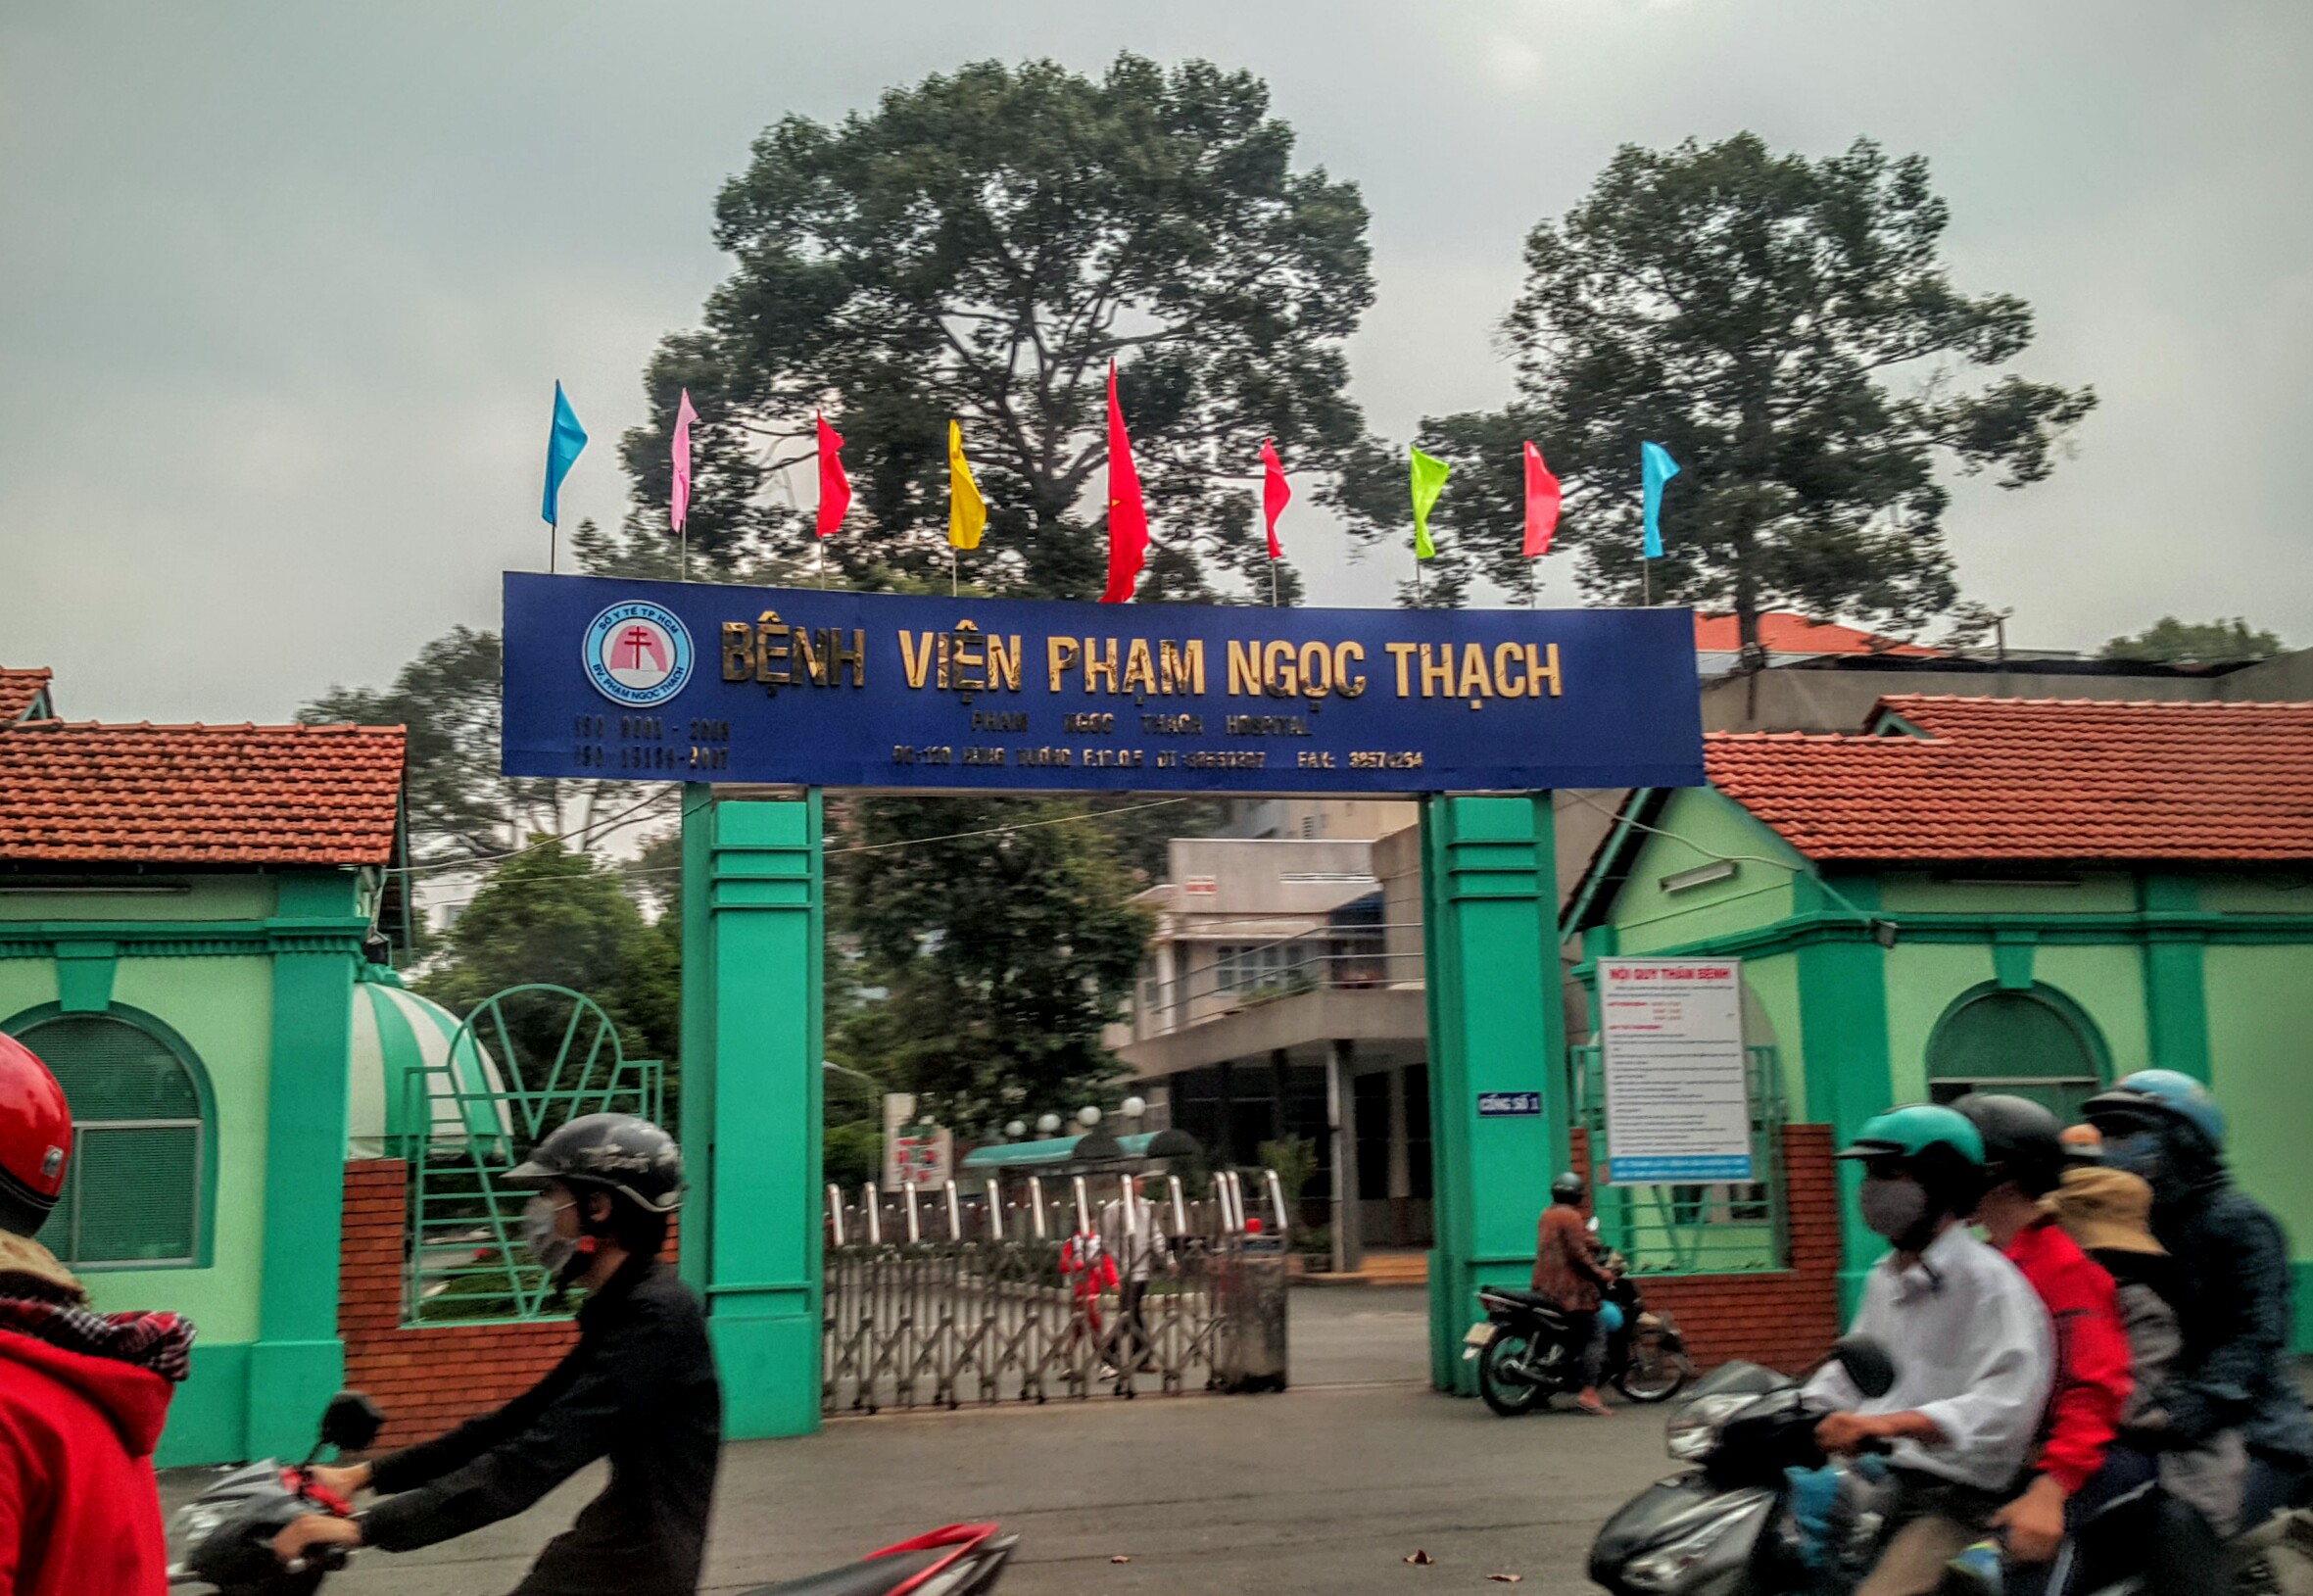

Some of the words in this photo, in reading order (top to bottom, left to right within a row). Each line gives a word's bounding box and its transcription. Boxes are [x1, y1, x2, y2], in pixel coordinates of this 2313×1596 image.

[656, 614, 679, 635] HCM
[722, 610, 865, 699] BỆNH
[898, 619, 1023, 704] VIỆN
[1047, 636, 1206, 706] PHẠM
[1227, 640, 1367, 712] NGỌC
[1384, 642, 1563, 710] THẠCH
